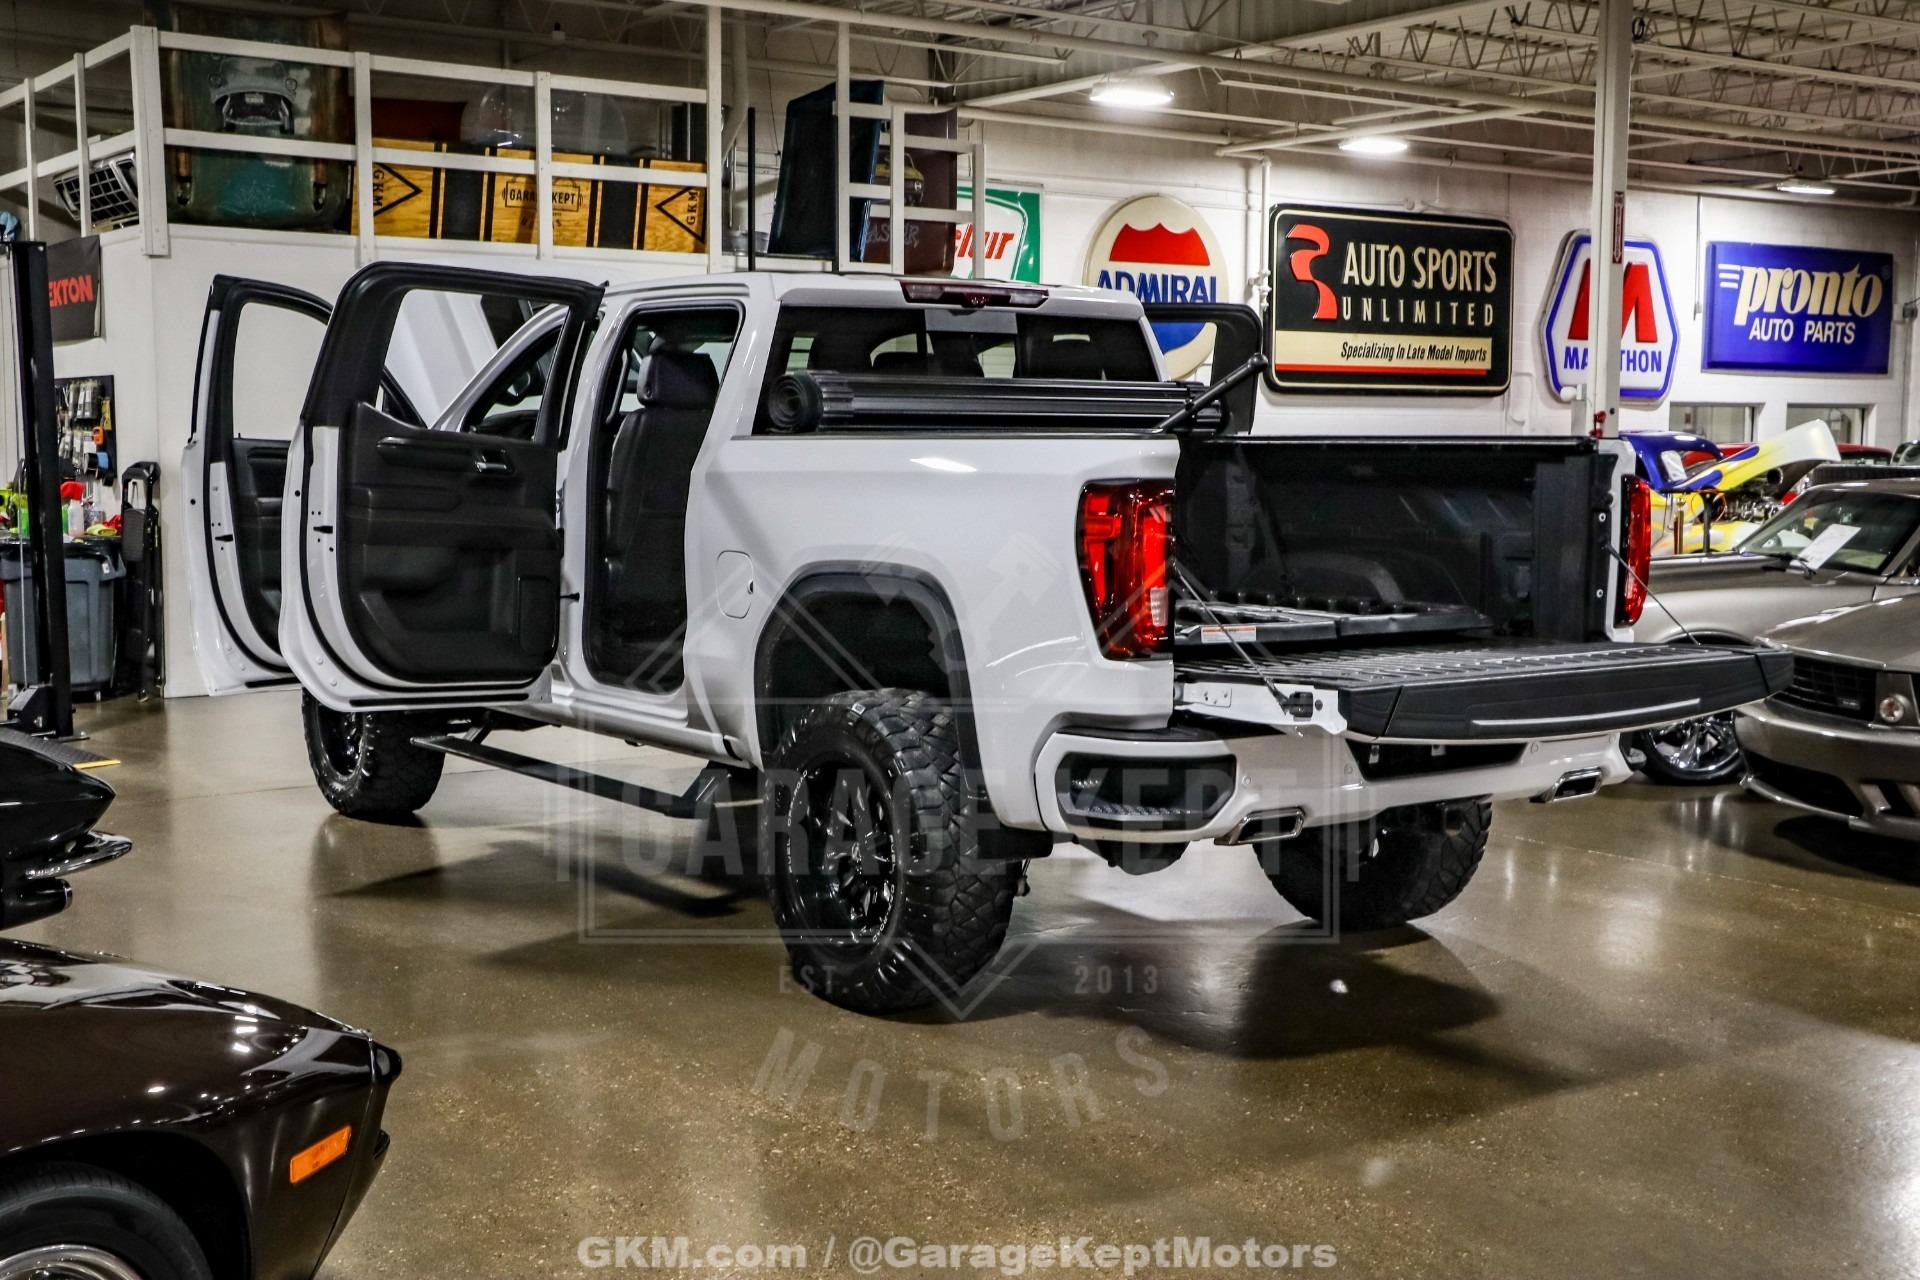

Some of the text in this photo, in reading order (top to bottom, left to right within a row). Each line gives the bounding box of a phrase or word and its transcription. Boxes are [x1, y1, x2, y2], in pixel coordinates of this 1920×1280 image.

[687, 191, 699, 225] GKM
[1343, 241, 1497, 293] AUTO SPORTS
[1733, 262, 1883, 326] pronto
[1342, 296, 1494, 326] UNLIMITED
[1749, 317, 1856, 344] AUTO PARTS
[1341, 341, 1487, 364] Specializing In Late Model Imports
